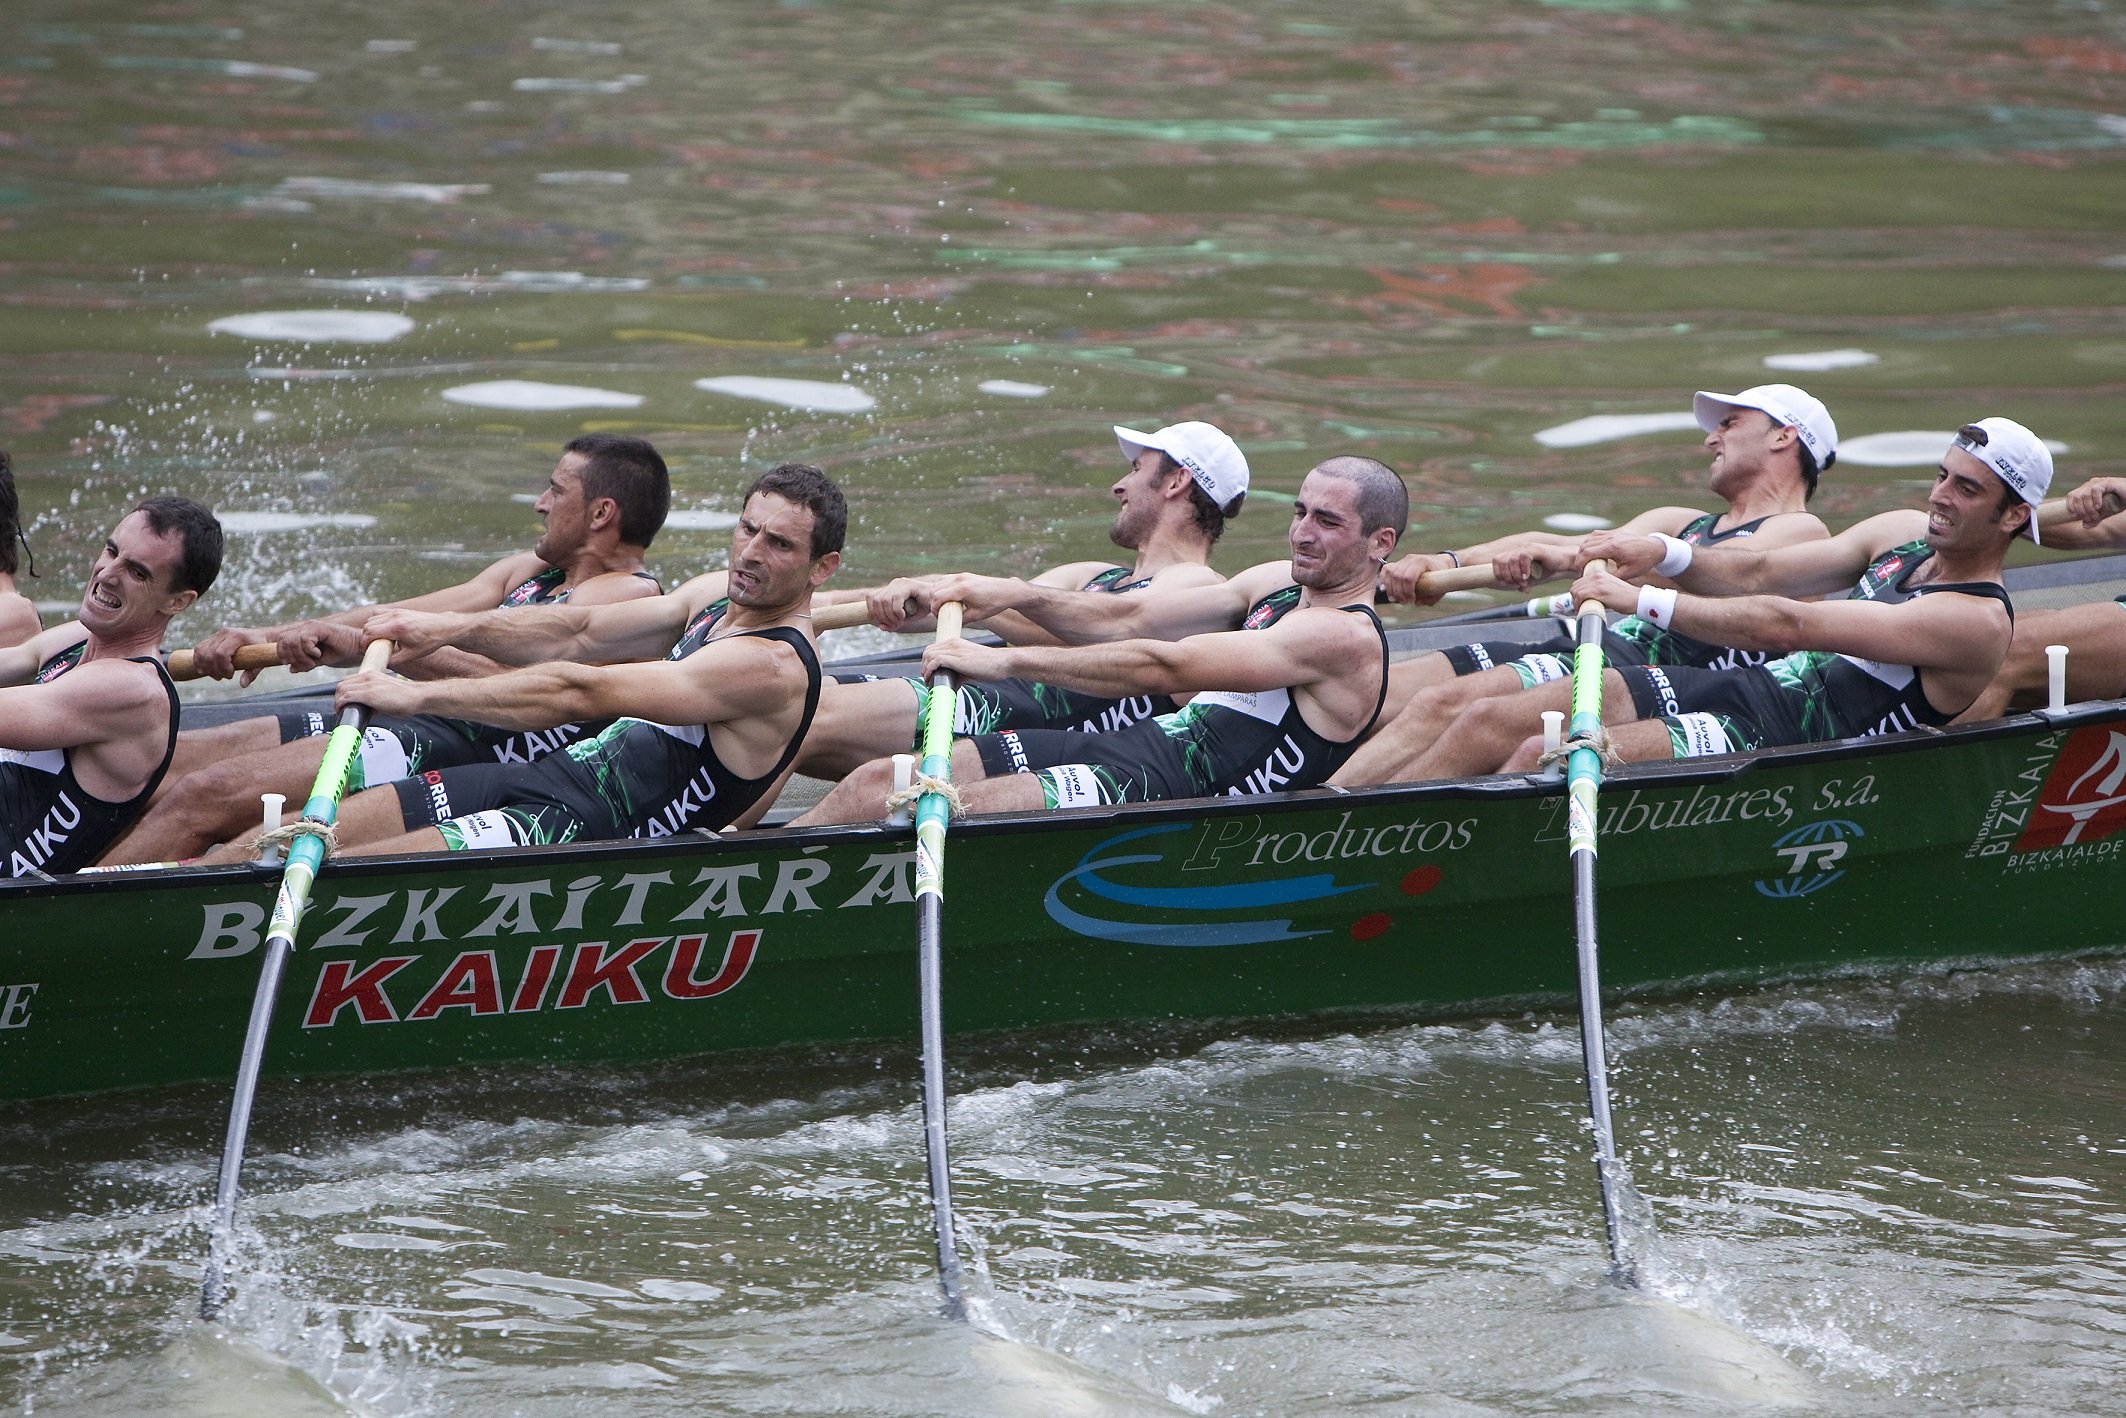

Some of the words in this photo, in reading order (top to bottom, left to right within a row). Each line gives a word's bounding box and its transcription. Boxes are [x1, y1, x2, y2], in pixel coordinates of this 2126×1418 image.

[1469, 643, 1495, 671] RRE
[1066, 693, 1154, 734] AIKU
[1642, 664, 1679, 717] RREO
[493, 723, 581, 764] KAIK
[999, 729, 1031, 774] RREO
[1213, 733, 1305, 798] AIKU
[627, 765, 717, 839] AIKU
[1813, 774, 1881, 811] s.a.
[1979, 728, 2071, 858] BIZKAIA
[0, 790, 81, 878] AIKU
[1182, 810, 1479, 871] Productos
[1965, 789, 2007, 859] FUNDACION
[2001, 854, 2118, 876] FUNDAZIOA
[2007, 839, 2124, 868] BIZKAIALDE
[302, 928, 764, 1029] KAIKU
